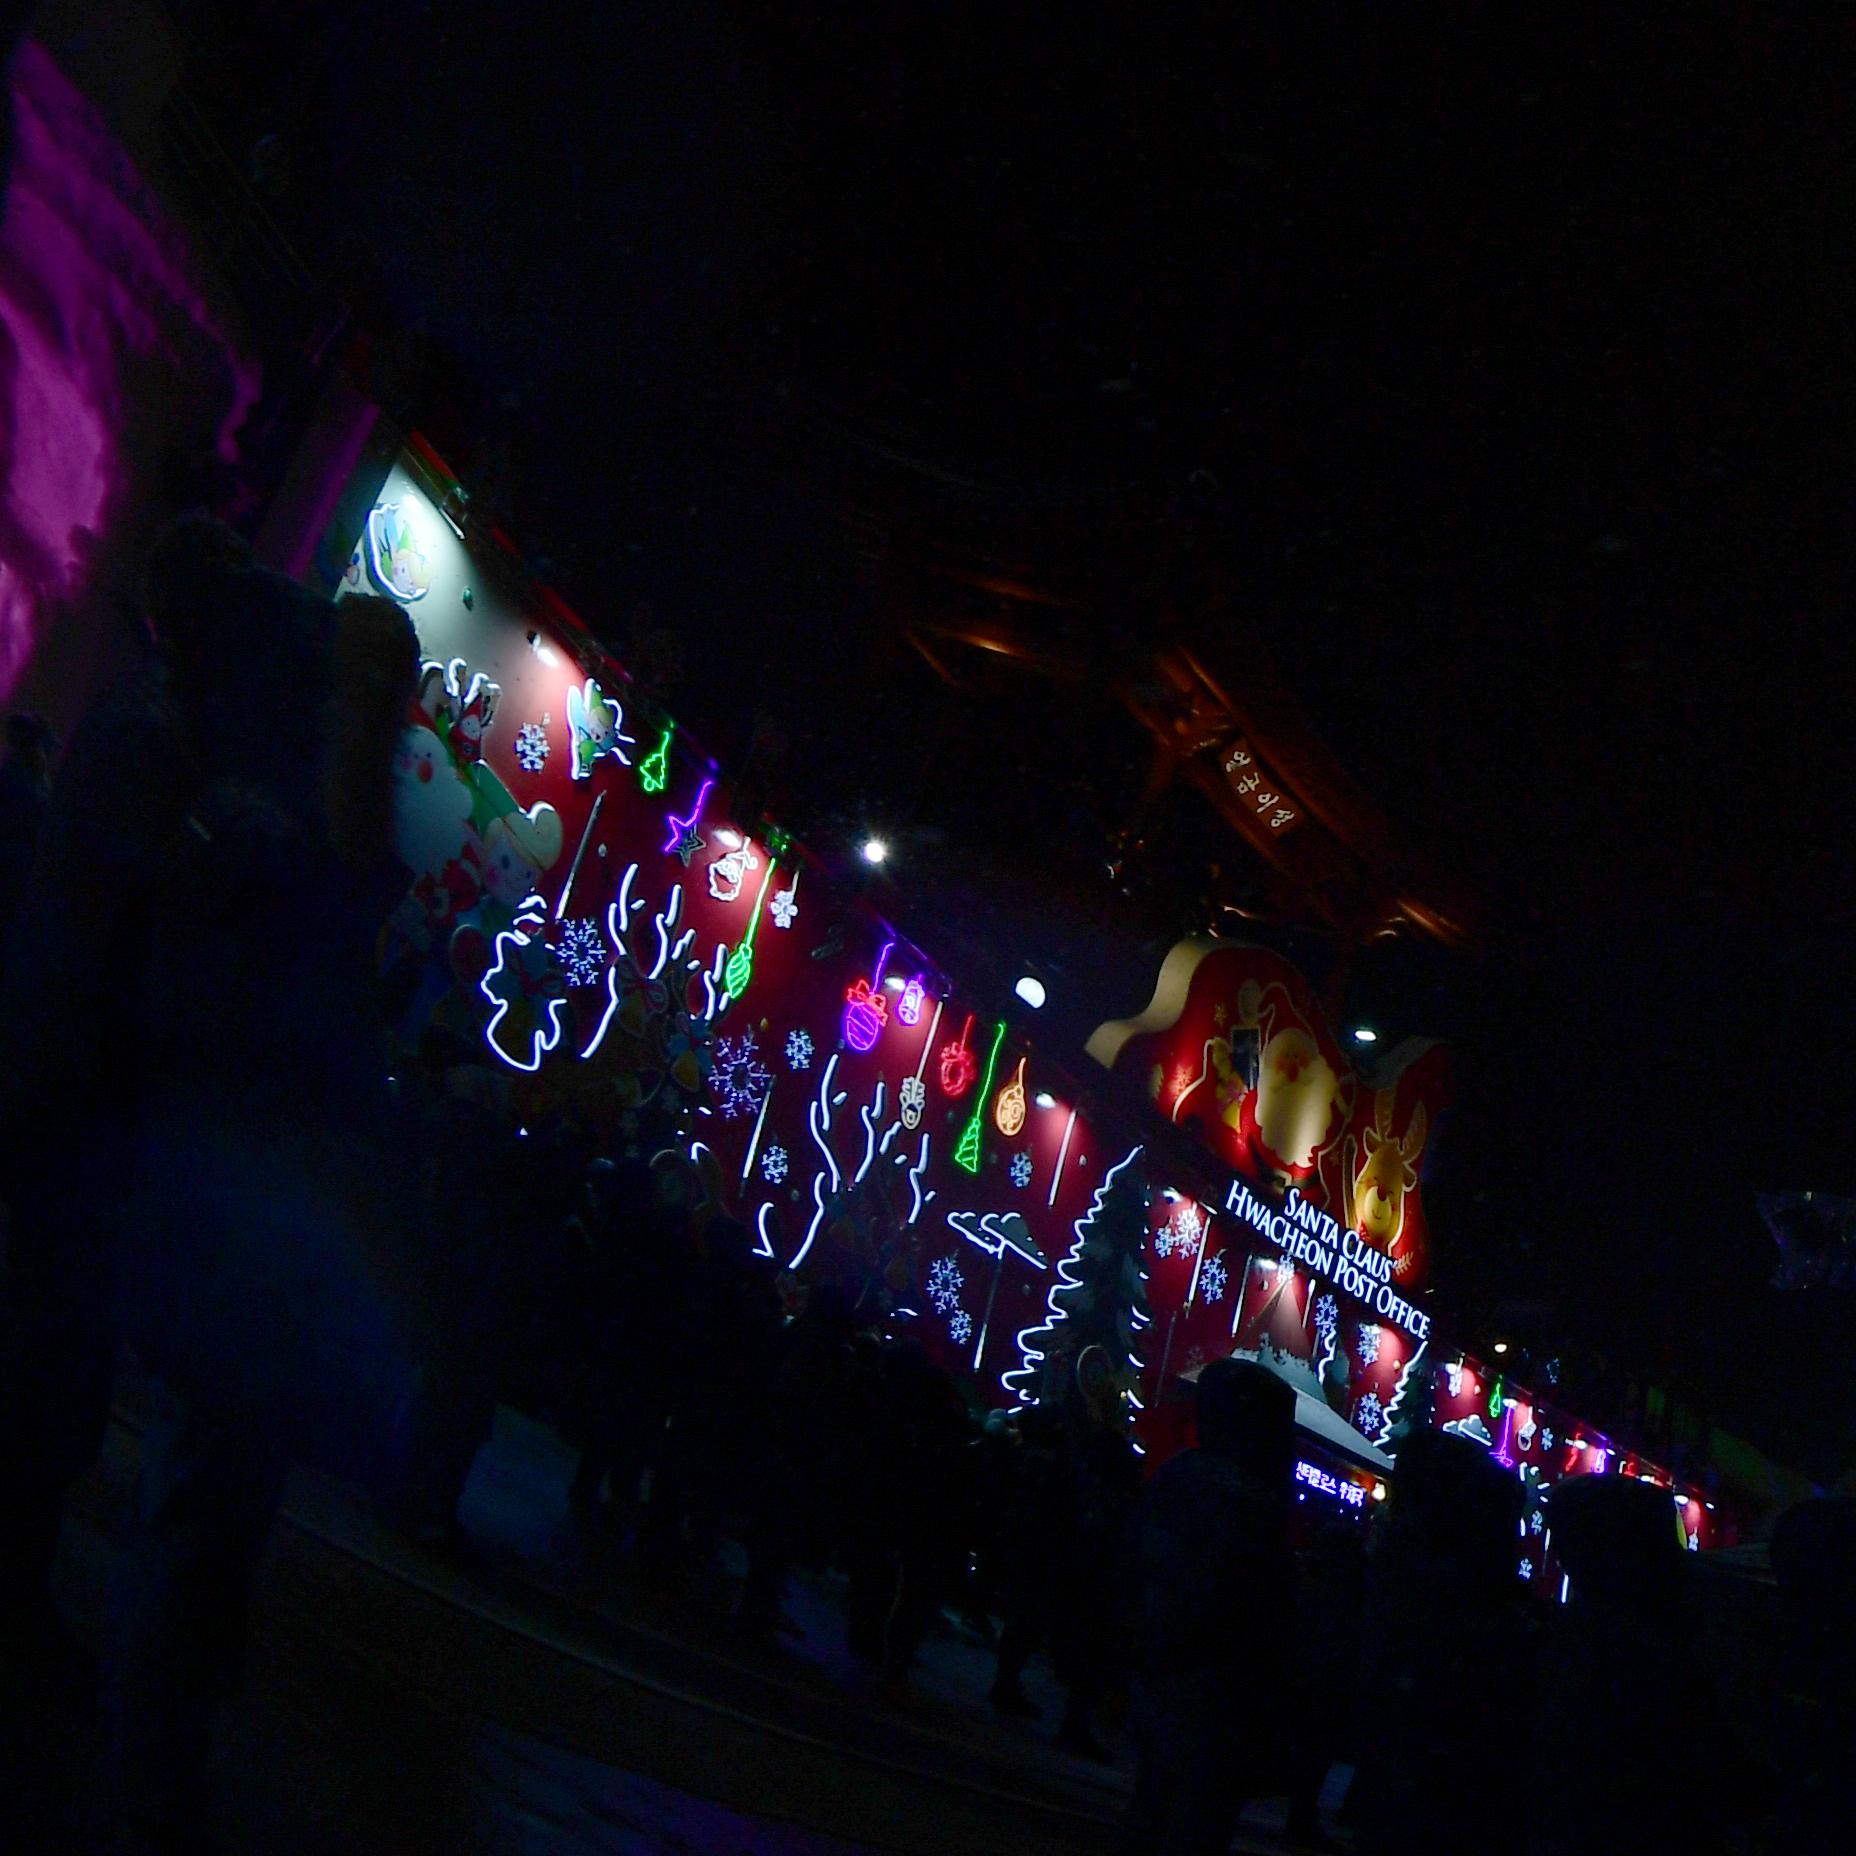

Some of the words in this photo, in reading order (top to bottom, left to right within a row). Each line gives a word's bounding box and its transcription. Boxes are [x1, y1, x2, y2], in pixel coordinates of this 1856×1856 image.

[1225, 1179, 1335, 1276] HWACHEON
[1333, 1254, 1378, 1304] POST
[1376, 1285, 1431, 1340] OFFICE
[1284, 1187, 1340, 1250] SANTA
[1342, 1230, 1393, 1284] CLAUS
